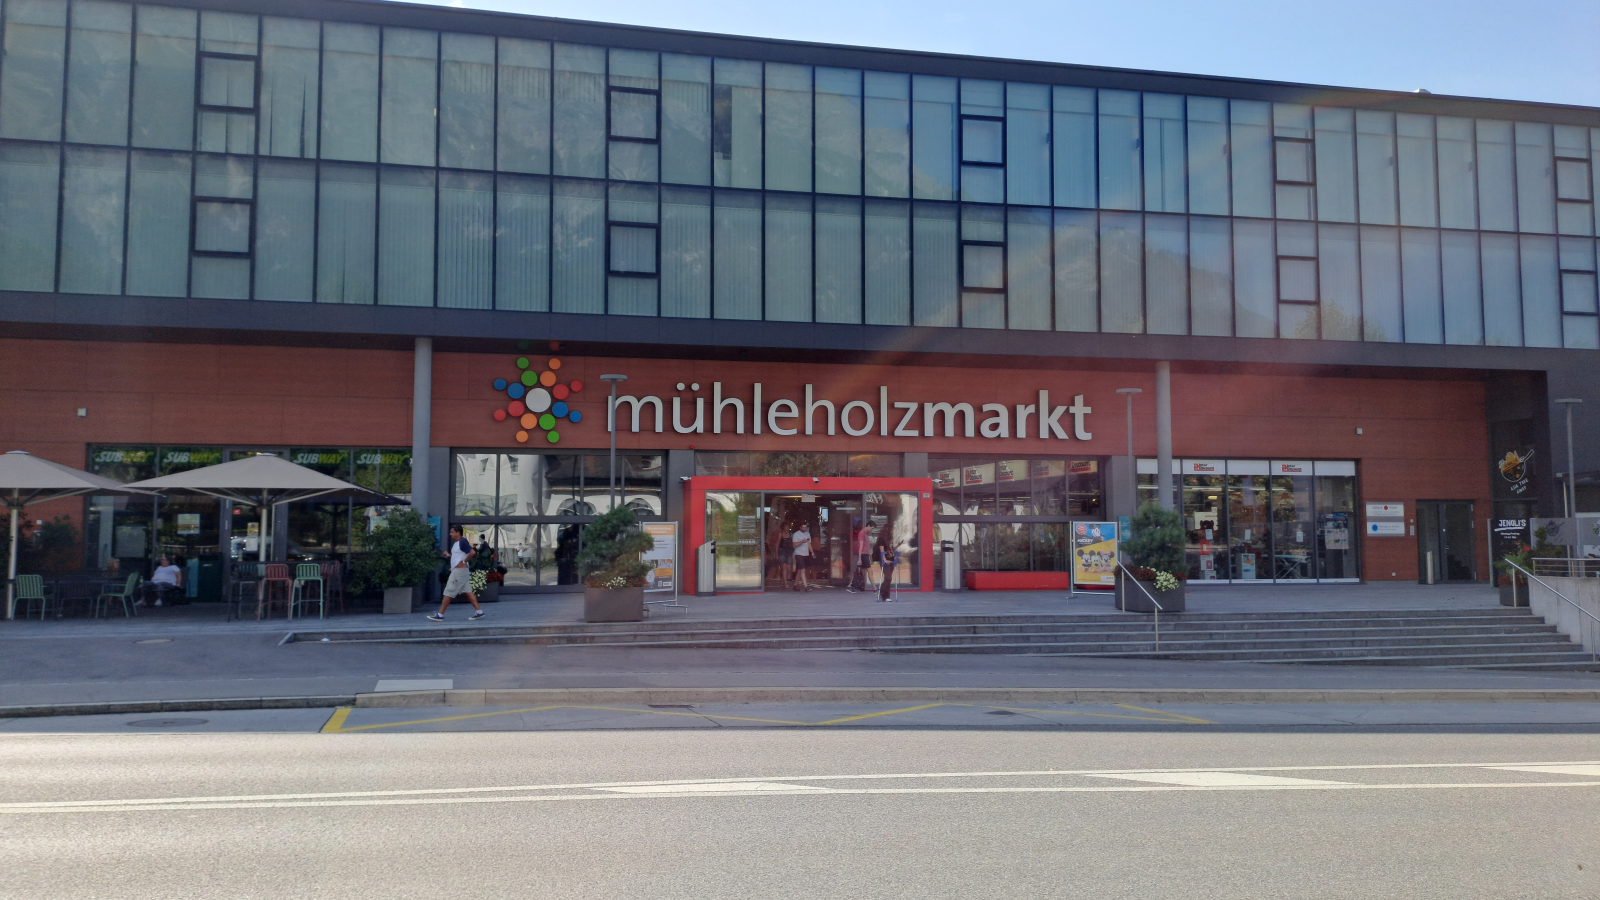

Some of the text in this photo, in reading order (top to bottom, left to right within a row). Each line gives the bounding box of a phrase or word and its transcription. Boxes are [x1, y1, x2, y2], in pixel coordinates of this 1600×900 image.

[607, 381, 1093, 442] mühleholzmarkt
[163, 451, 222, 463] SUBWAY
[293, 453, 349, 464] SUBWAY
[356, 453, 411, 465] SUBWAY
